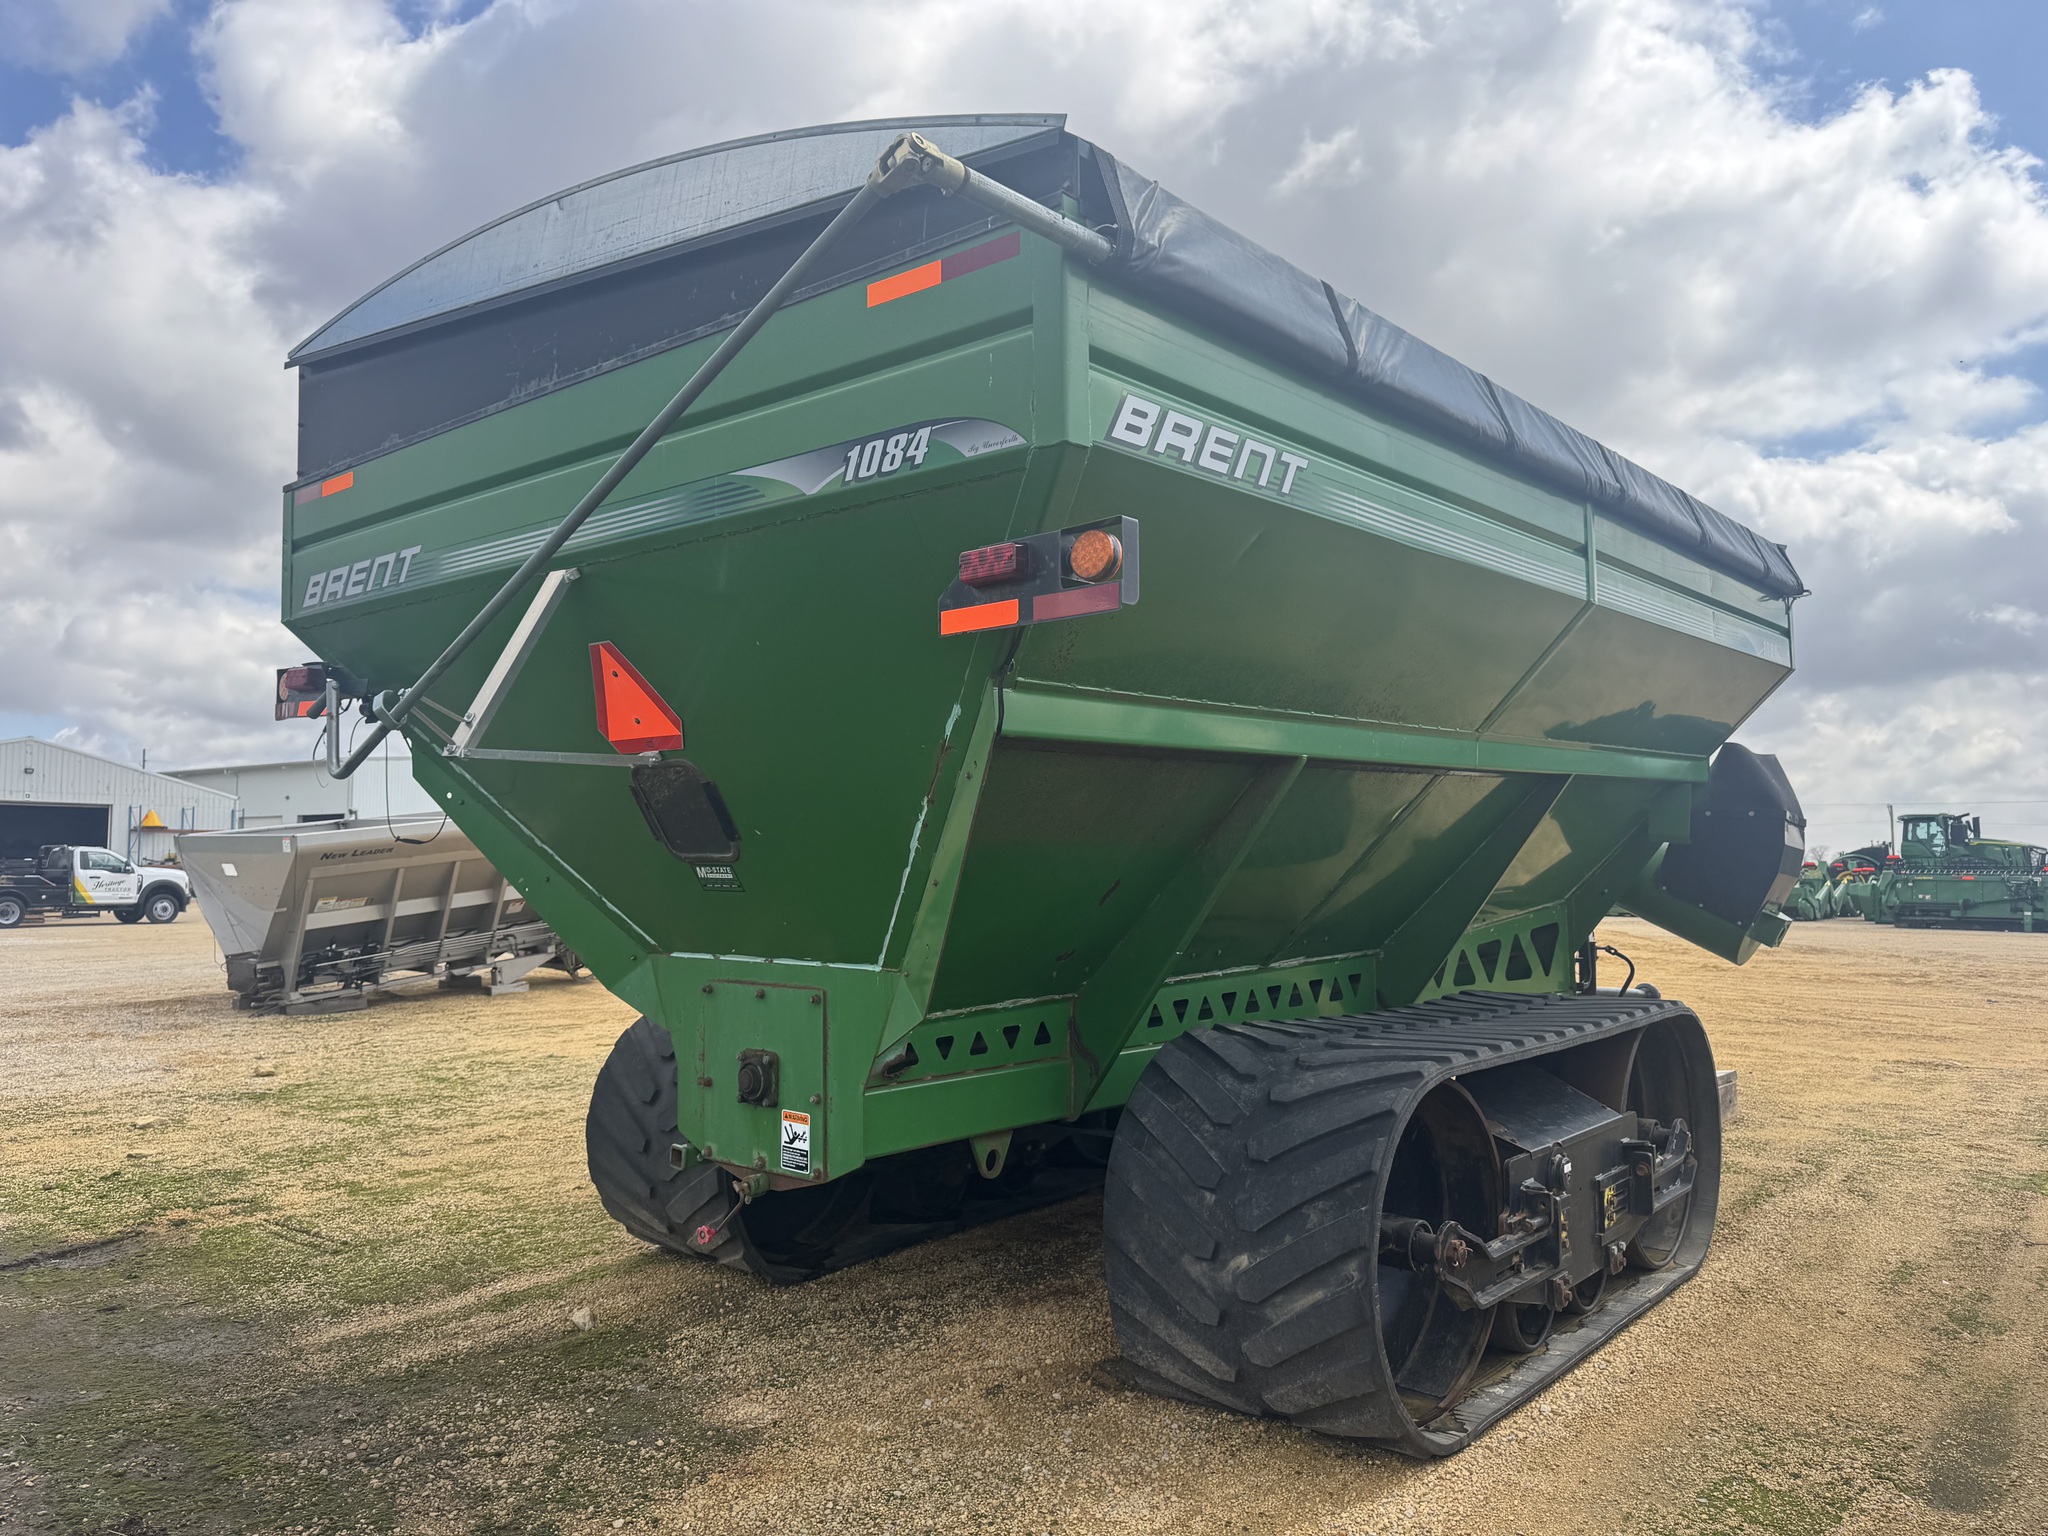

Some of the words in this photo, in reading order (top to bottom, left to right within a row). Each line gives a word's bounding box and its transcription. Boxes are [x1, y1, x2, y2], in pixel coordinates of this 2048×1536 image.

[844, 426, 932, 482] 1084
[1109, 392, 1310, 496] BRENT
[302, 544, 422, 608] BRENT
[92, 879, 126, 891] Heritage
[788, 1113, 808, 1123] WARNING
